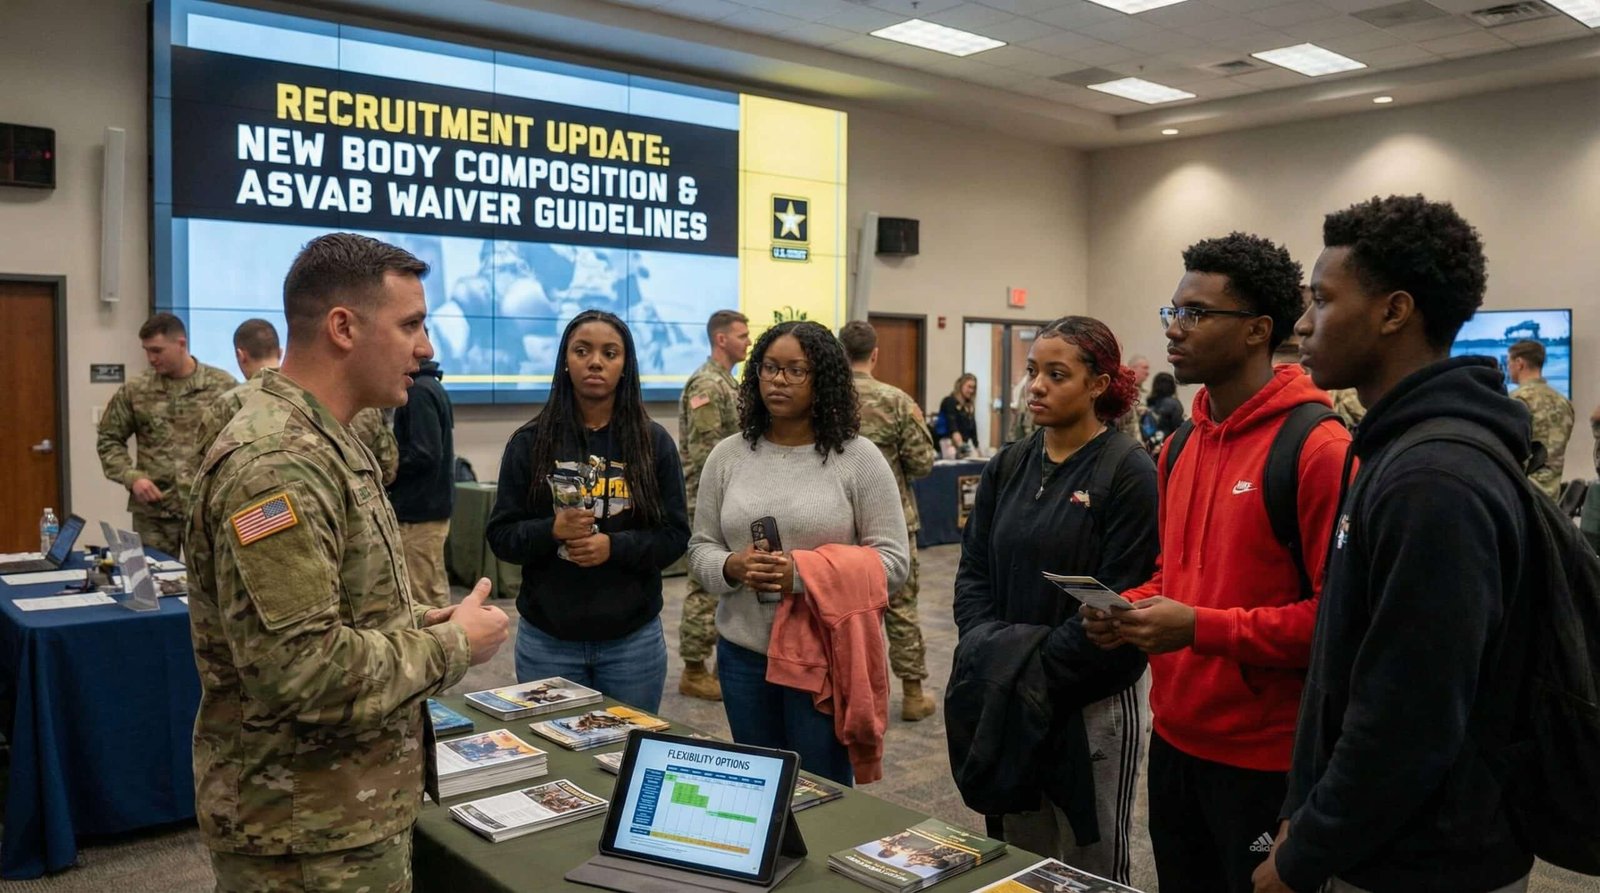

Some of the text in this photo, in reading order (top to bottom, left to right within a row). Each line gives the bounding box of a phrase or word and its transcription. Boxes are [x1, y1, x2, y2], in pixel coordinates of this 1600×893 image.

[276, 82, 670, 167] RECRUITMENT UPDATE:
[237, 123, 699, 206] NEW BODY COMPOSITION &
[235, 168, 708, 242] ASVAB WAIVER GUIDELINES
[667, 748, 750, 771] FLEXIBILITY OPTIONS
